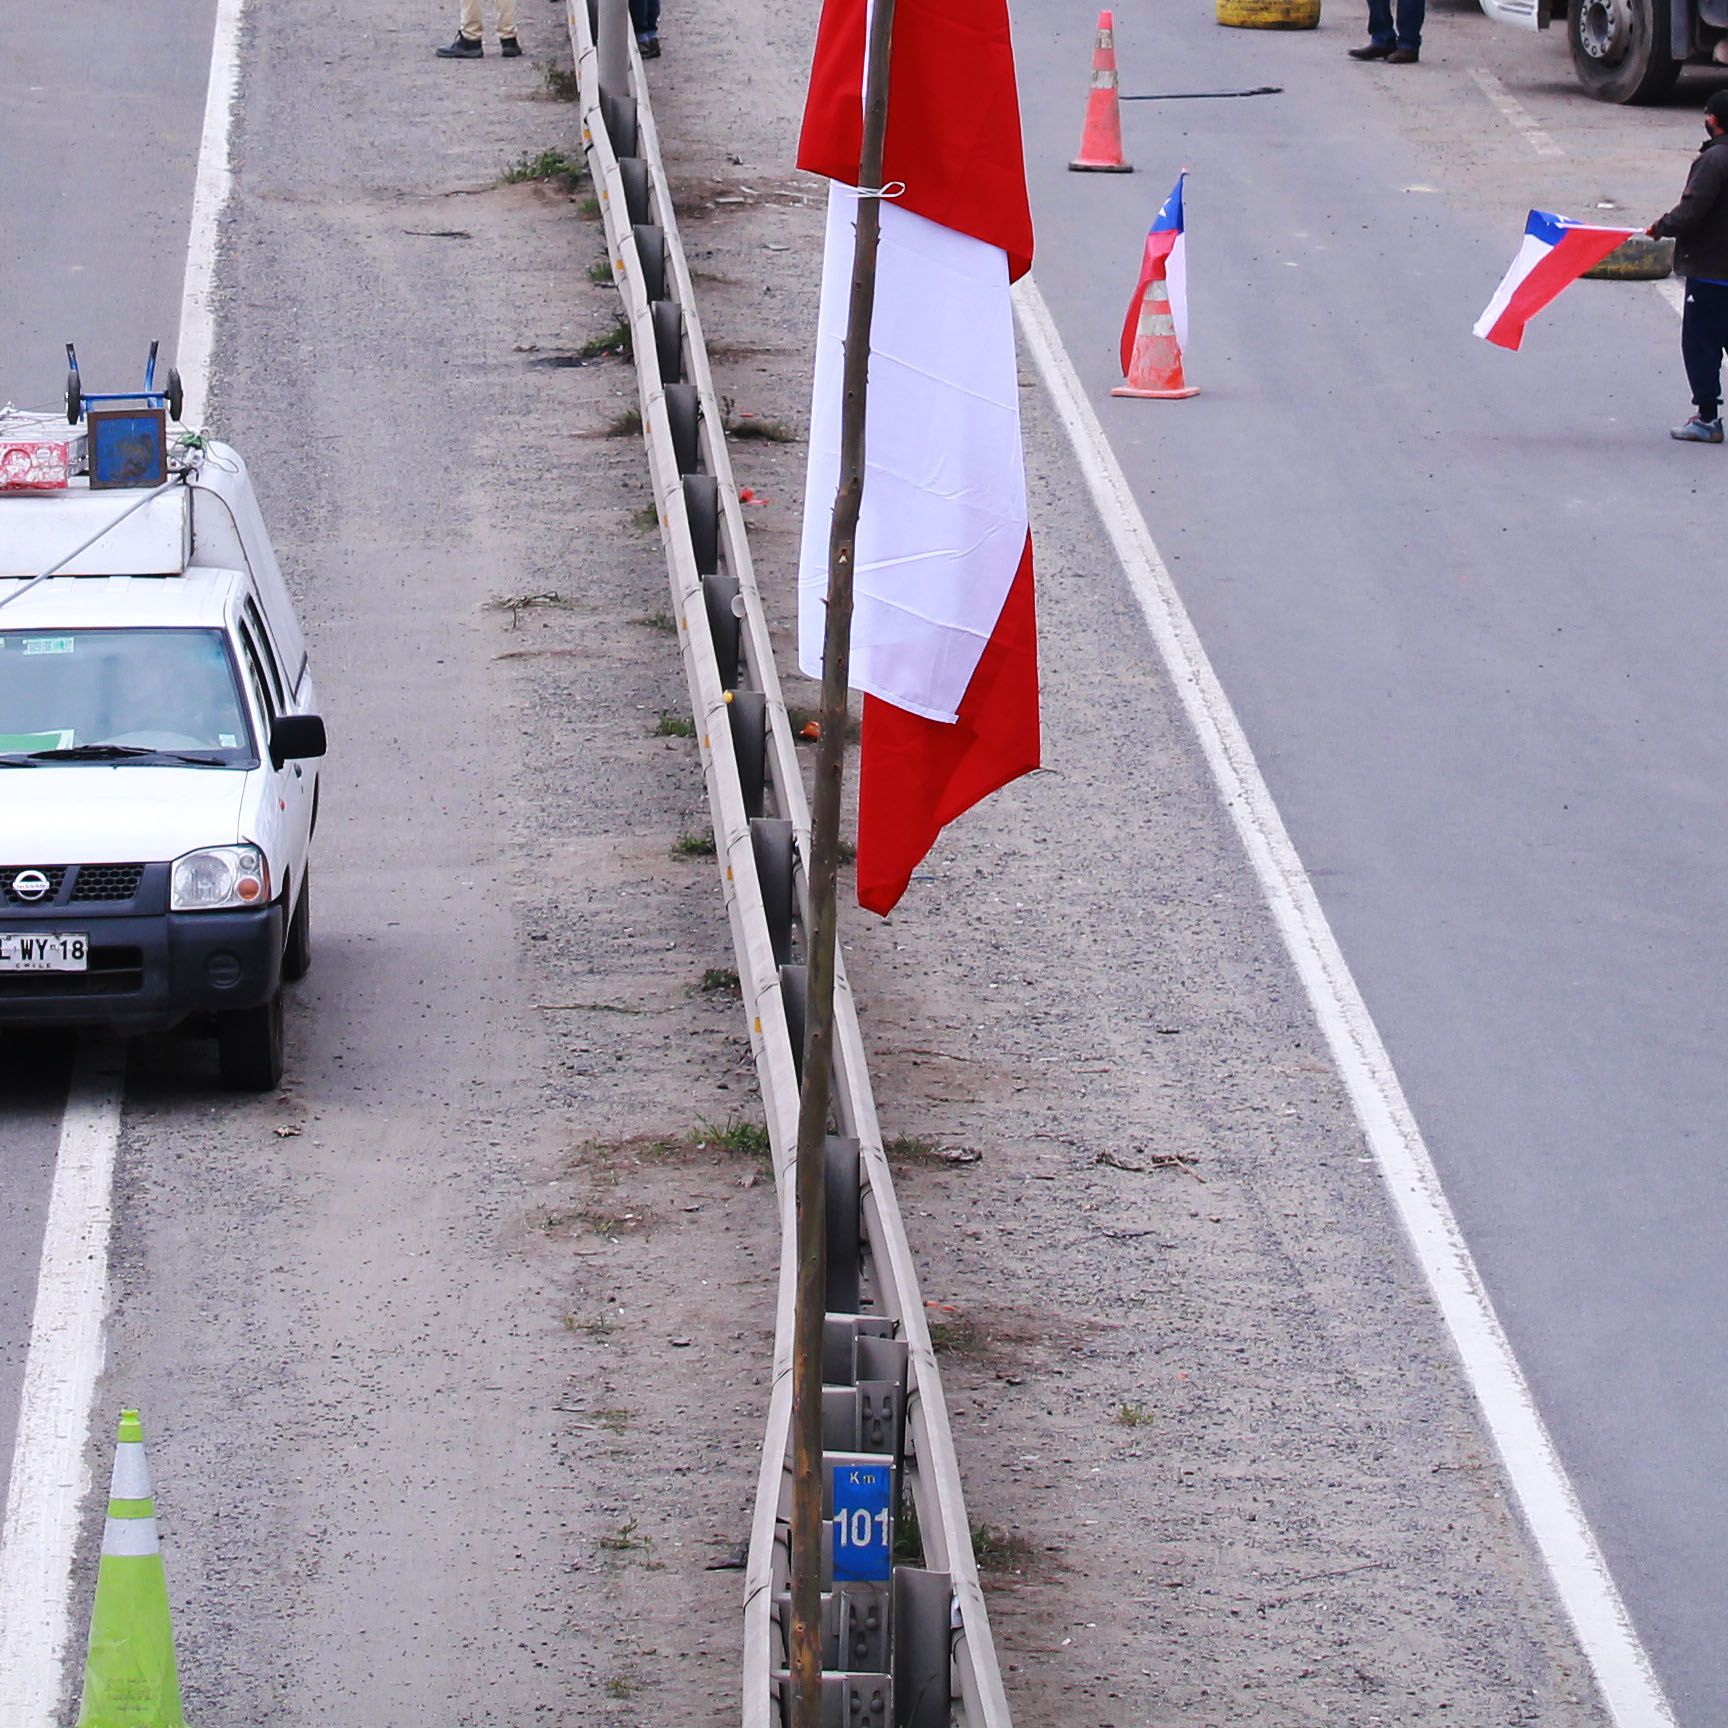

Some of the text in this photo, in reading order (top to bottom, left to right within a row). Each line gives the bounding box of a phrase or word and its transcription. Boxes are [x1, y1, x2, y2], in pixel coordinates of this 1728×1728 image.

[20, 939, 48, 960] WY
[59, 940, 84, 960] 18
[850, 1471, 876, 1485] Km
[833, 1507, 889, 1548] 101
